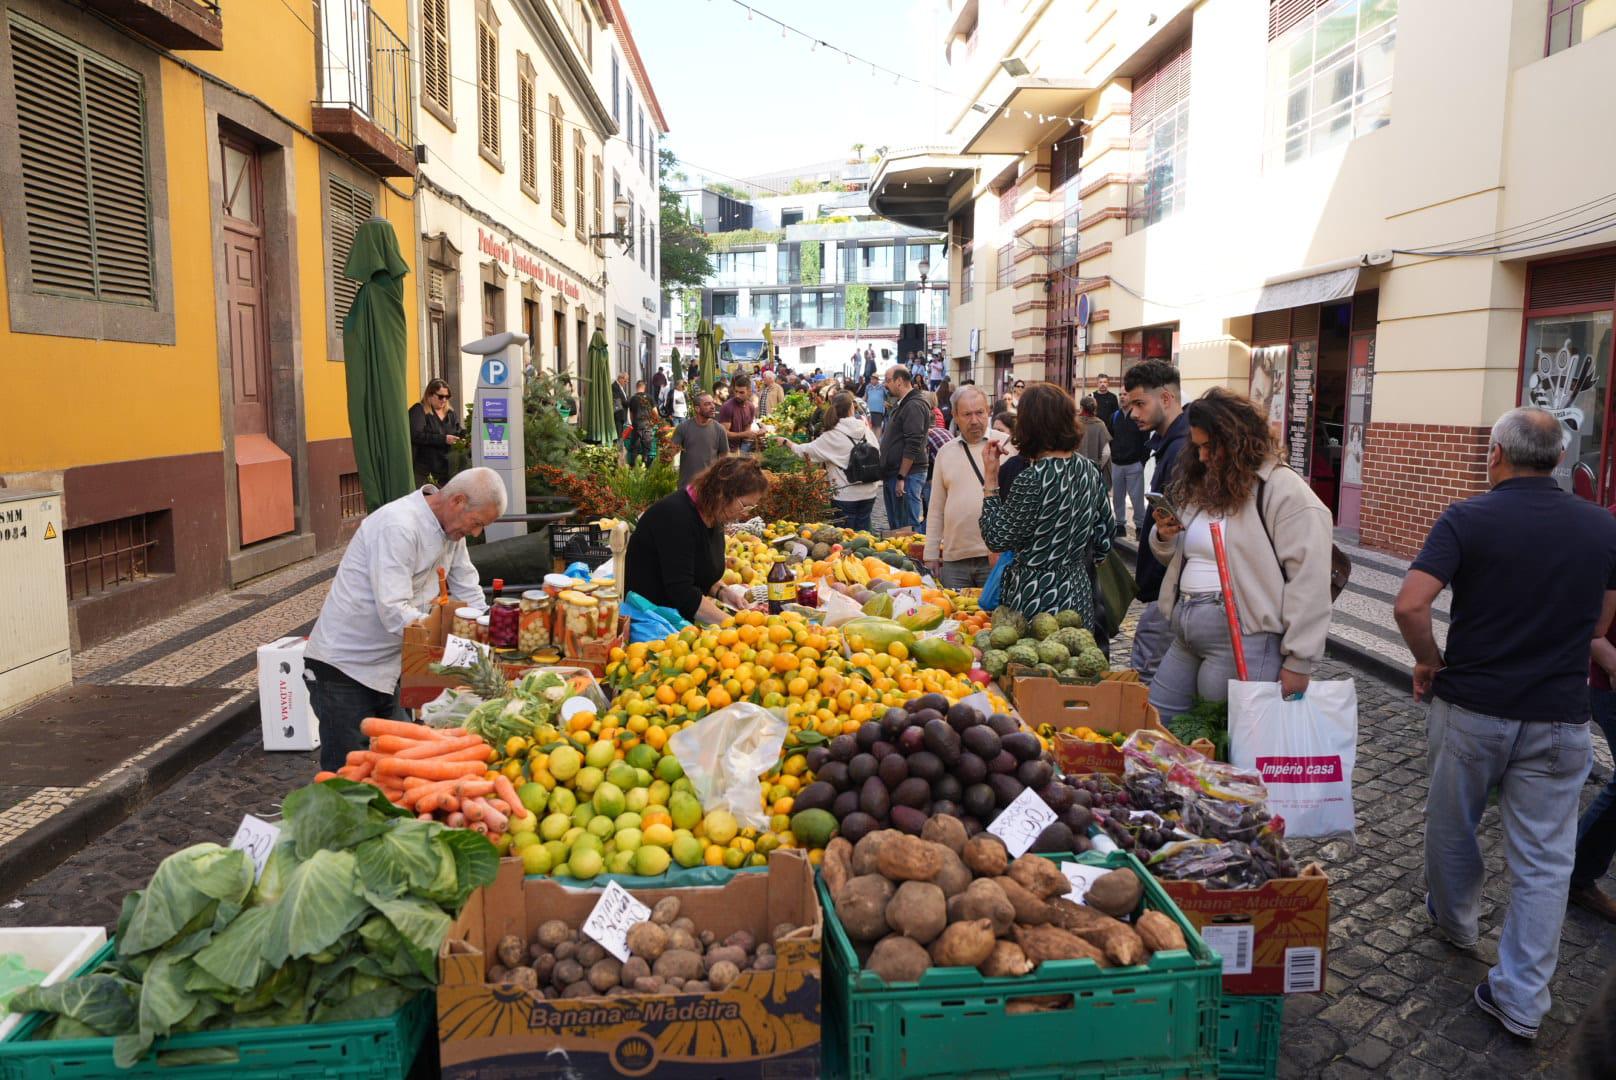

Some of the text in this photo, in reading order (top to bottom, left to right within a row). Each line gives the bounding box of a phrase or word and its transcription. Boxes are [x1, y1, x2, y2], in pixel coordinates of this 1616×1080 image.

[489, 360, 504, 384] P
[279, 679, 288, 721] ALDAMA
[1262, 762, 1334, 777] Império casa
[1246, 895, 1307, 908] Madeira
[529, 1007, 621, 1028] Banana
[643, 1001, 739, 1021] Madeira
